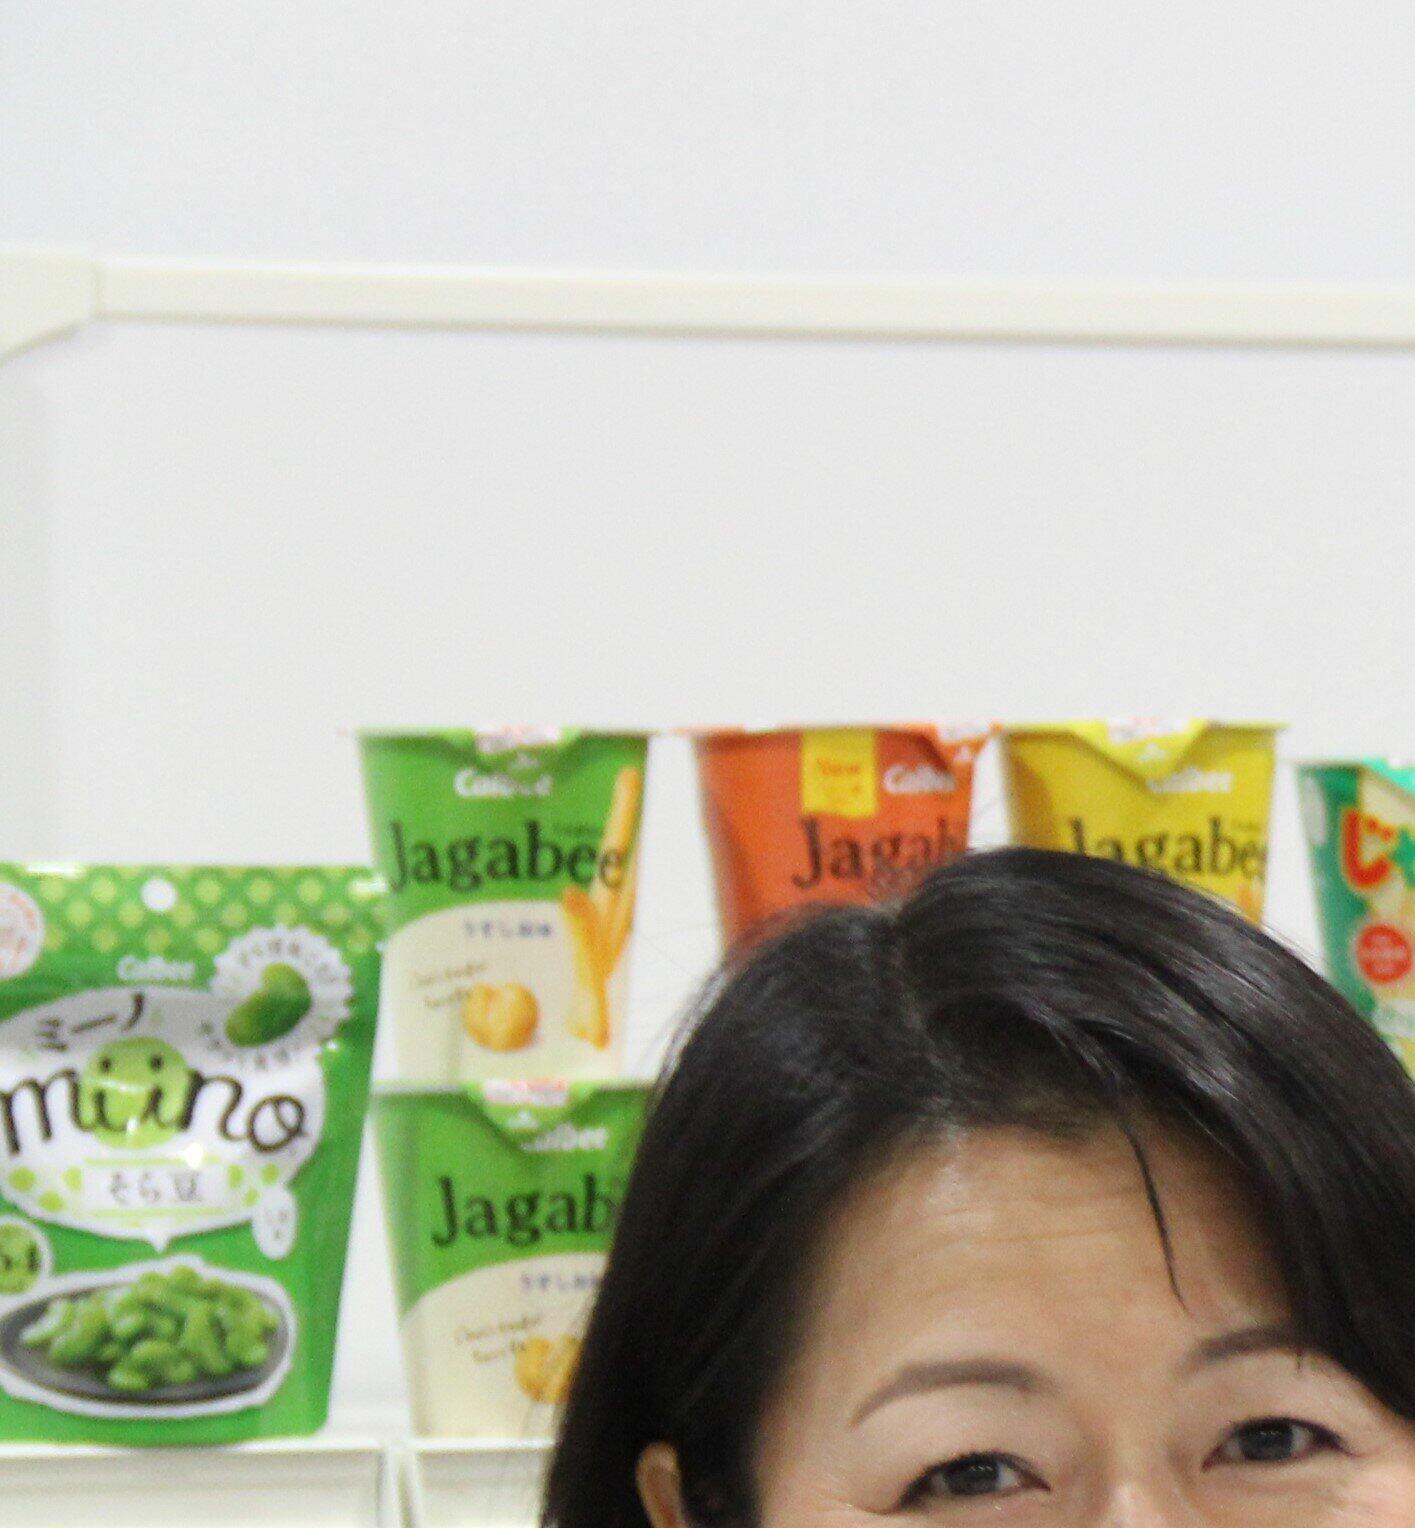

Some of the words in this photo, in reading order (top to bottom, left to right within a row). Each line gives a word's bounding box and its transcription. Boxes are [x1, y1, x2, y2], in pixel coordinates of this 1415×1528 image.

[387, 817, 625, 895] Jagabee
[36, 992, 146, 1052] ミーノ
[431, 1172, 616, 1249] Jagab
